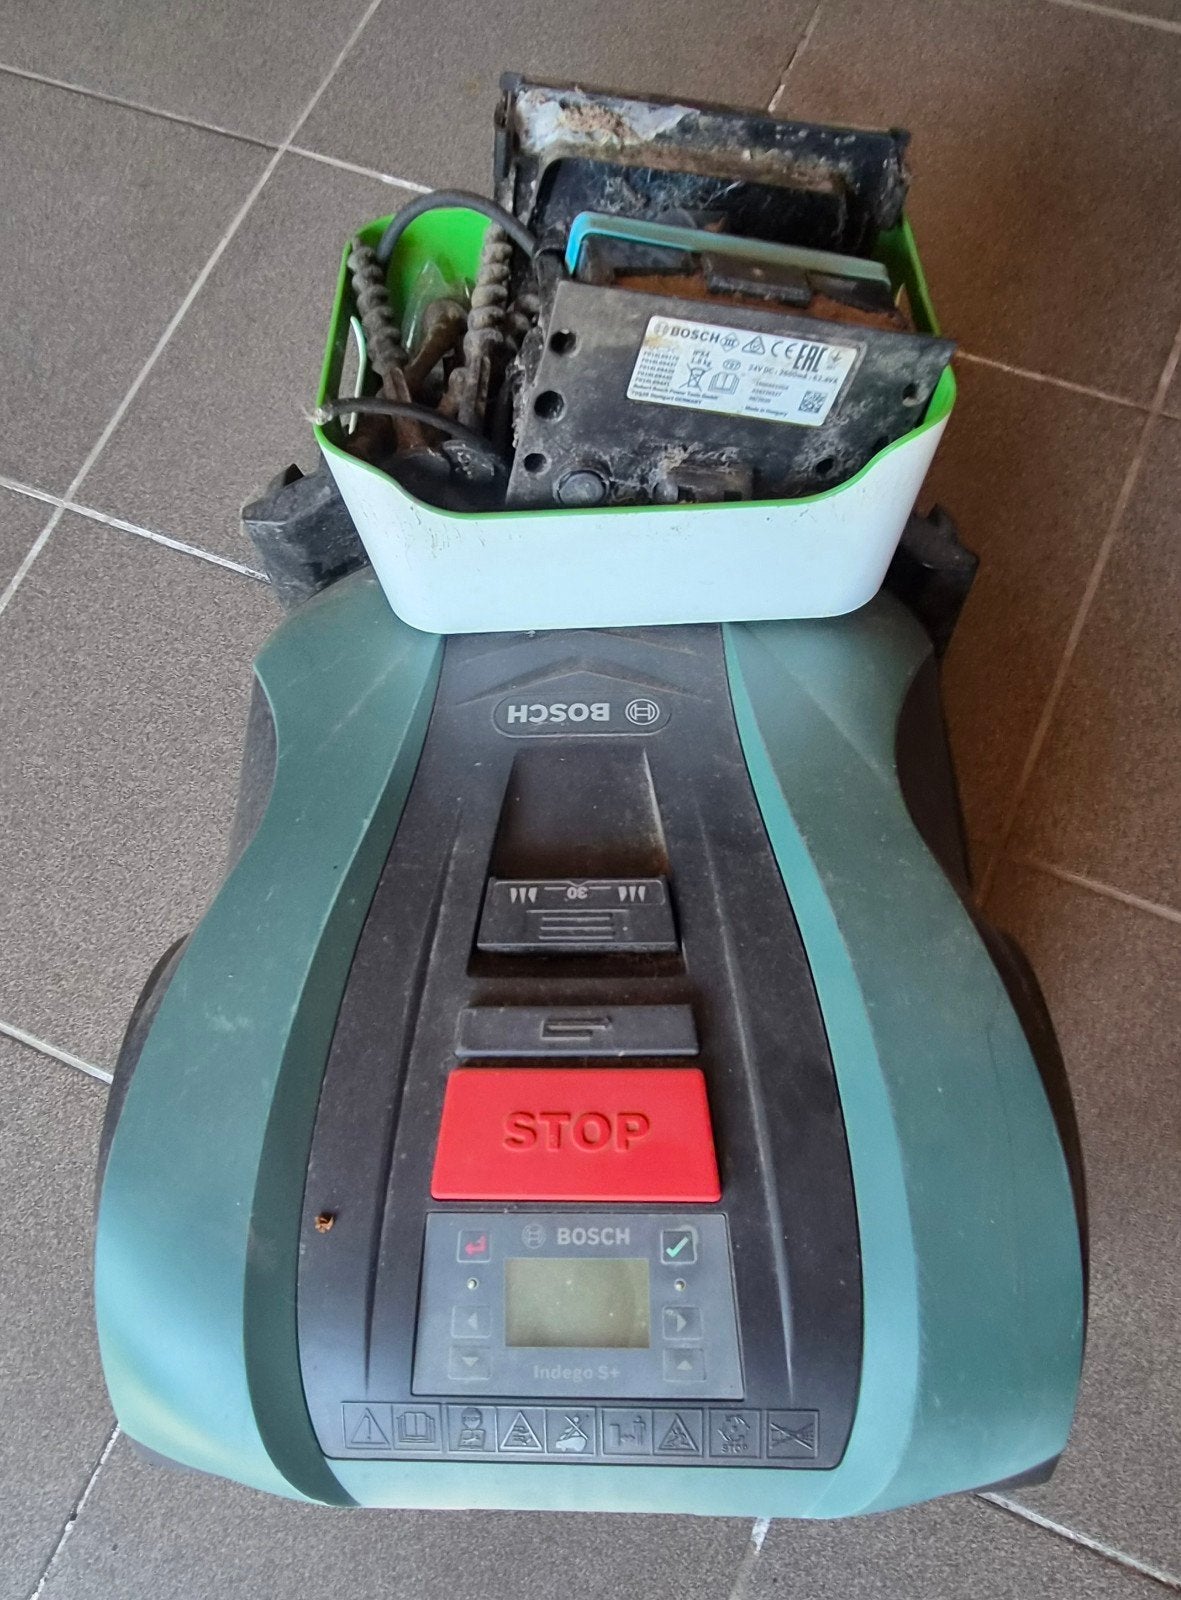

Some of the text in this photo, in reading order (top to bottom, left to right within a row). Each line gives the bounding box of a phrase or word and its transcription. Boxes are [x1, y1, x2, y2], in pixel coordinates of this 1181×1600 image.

[669, 326, 720, 343] BOSCH
[507, 703, 610, 724] BOSCH
[566, 886, 589, 900] 30
[503, 1111, 651, 1152] STOP
[556, 1227, 631, 1246] BOSCH
[533, 1364, 621, 1383] Indego S+
